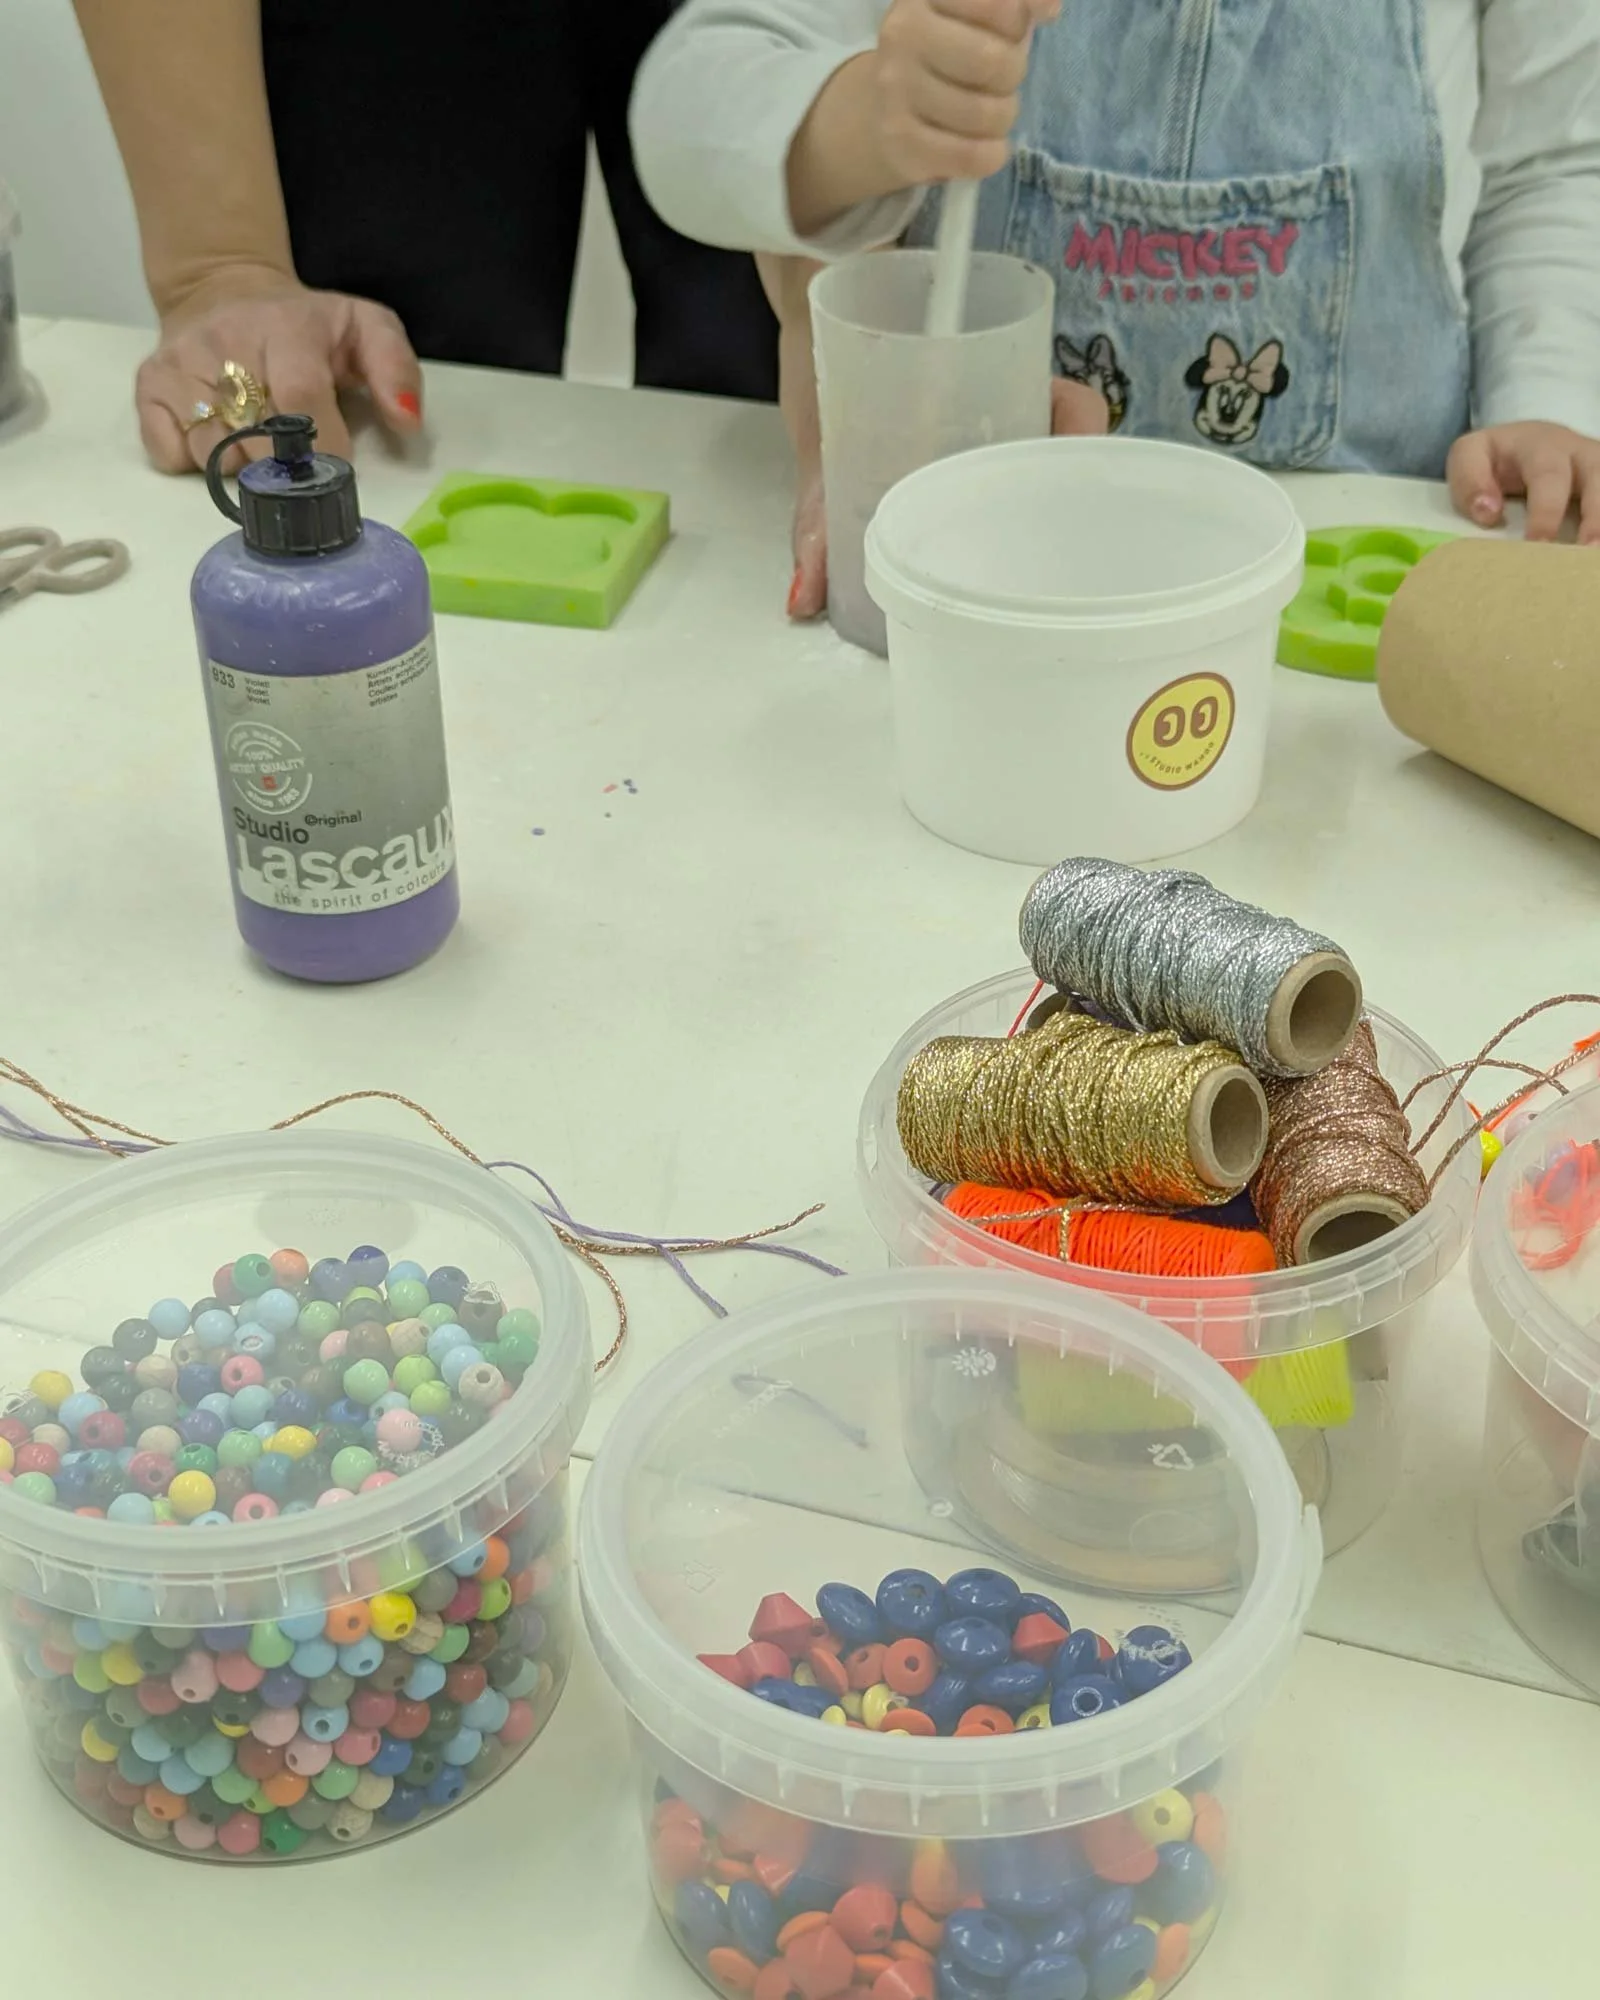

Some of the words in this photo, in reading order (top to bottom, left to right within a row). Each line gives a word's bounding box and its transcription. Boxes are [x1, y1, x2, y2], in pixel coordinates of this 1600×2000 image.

[1064, 221, 1299, 281] MICKEY
[211, 667, 236, 689] 933
[259, 757, 306, 774] QUALITY
[233, 806, 310, 845] Studio
[274, 889, 302, 907] the
[311, 893, 363, 910] spirit
[371, 886, 389, 904] of
[396, 861, 448, 897] colours
